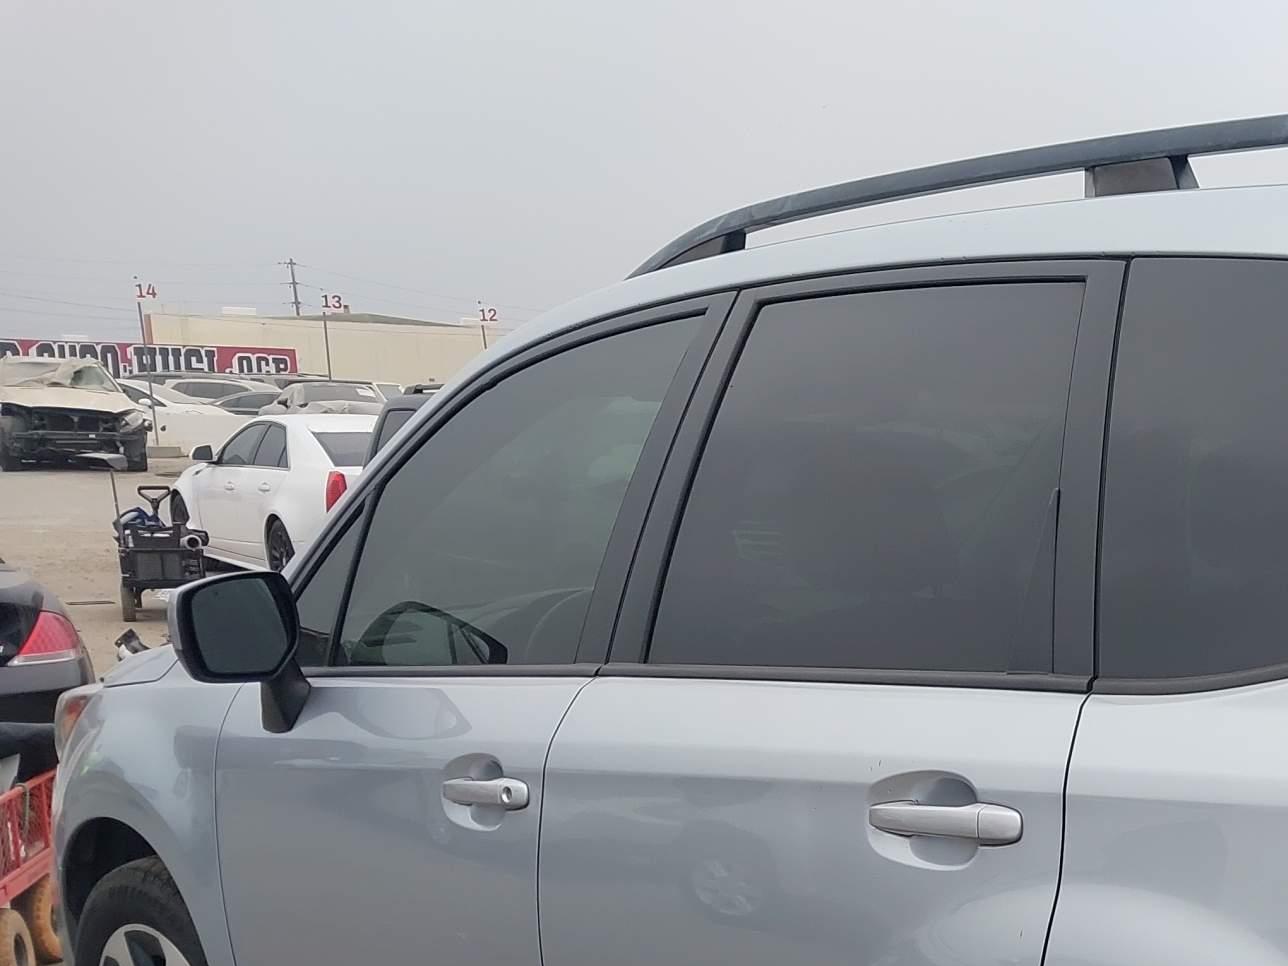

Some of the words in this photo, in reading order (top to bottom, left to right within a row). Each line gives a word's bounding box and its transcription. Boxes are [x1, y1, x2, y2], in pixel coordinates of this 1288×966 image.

[135, 283, 157, 299] 14
[321, 294, 343, 309] 13
[479, 308, 498, 322] 12
